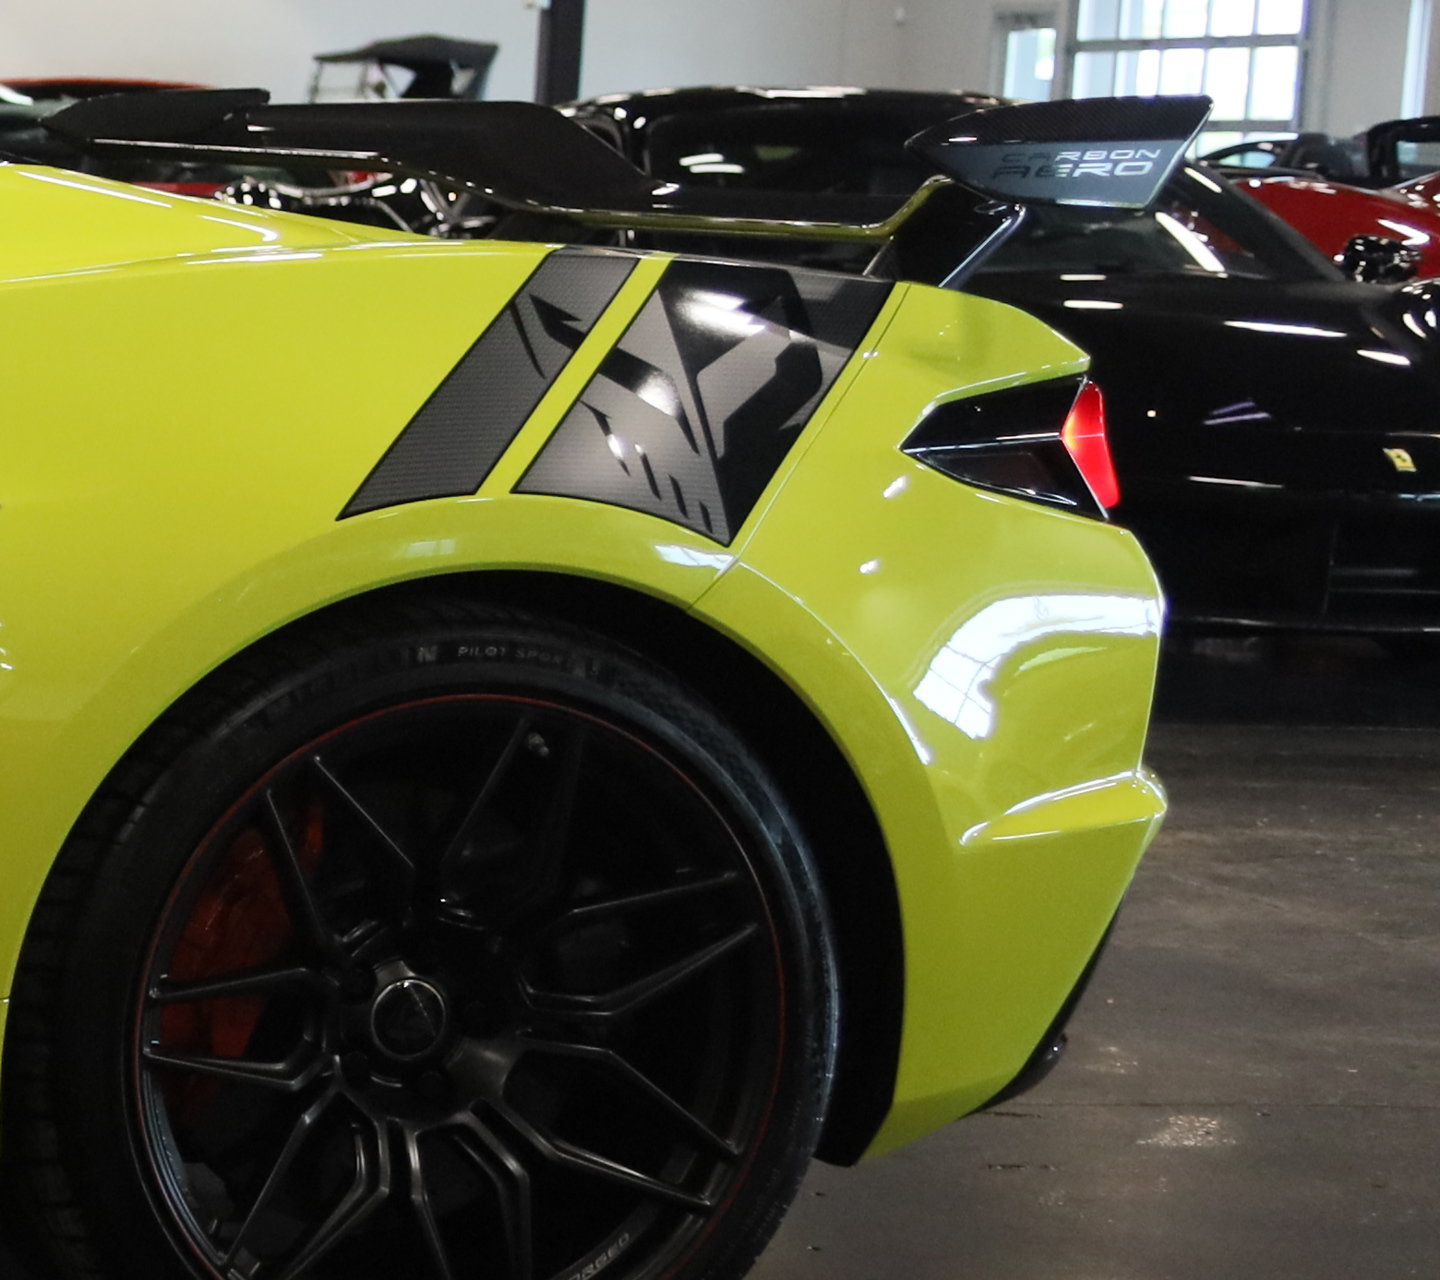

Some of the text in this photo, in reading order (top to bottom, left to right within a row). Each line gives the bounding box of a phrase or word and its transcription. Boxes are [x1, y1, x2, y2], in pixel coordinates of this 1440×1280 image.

[1001, 149, 1161, 163] CARBON
[992, 161, 1154, 179] AERO
[456, 645, 508, 658] PILOT
